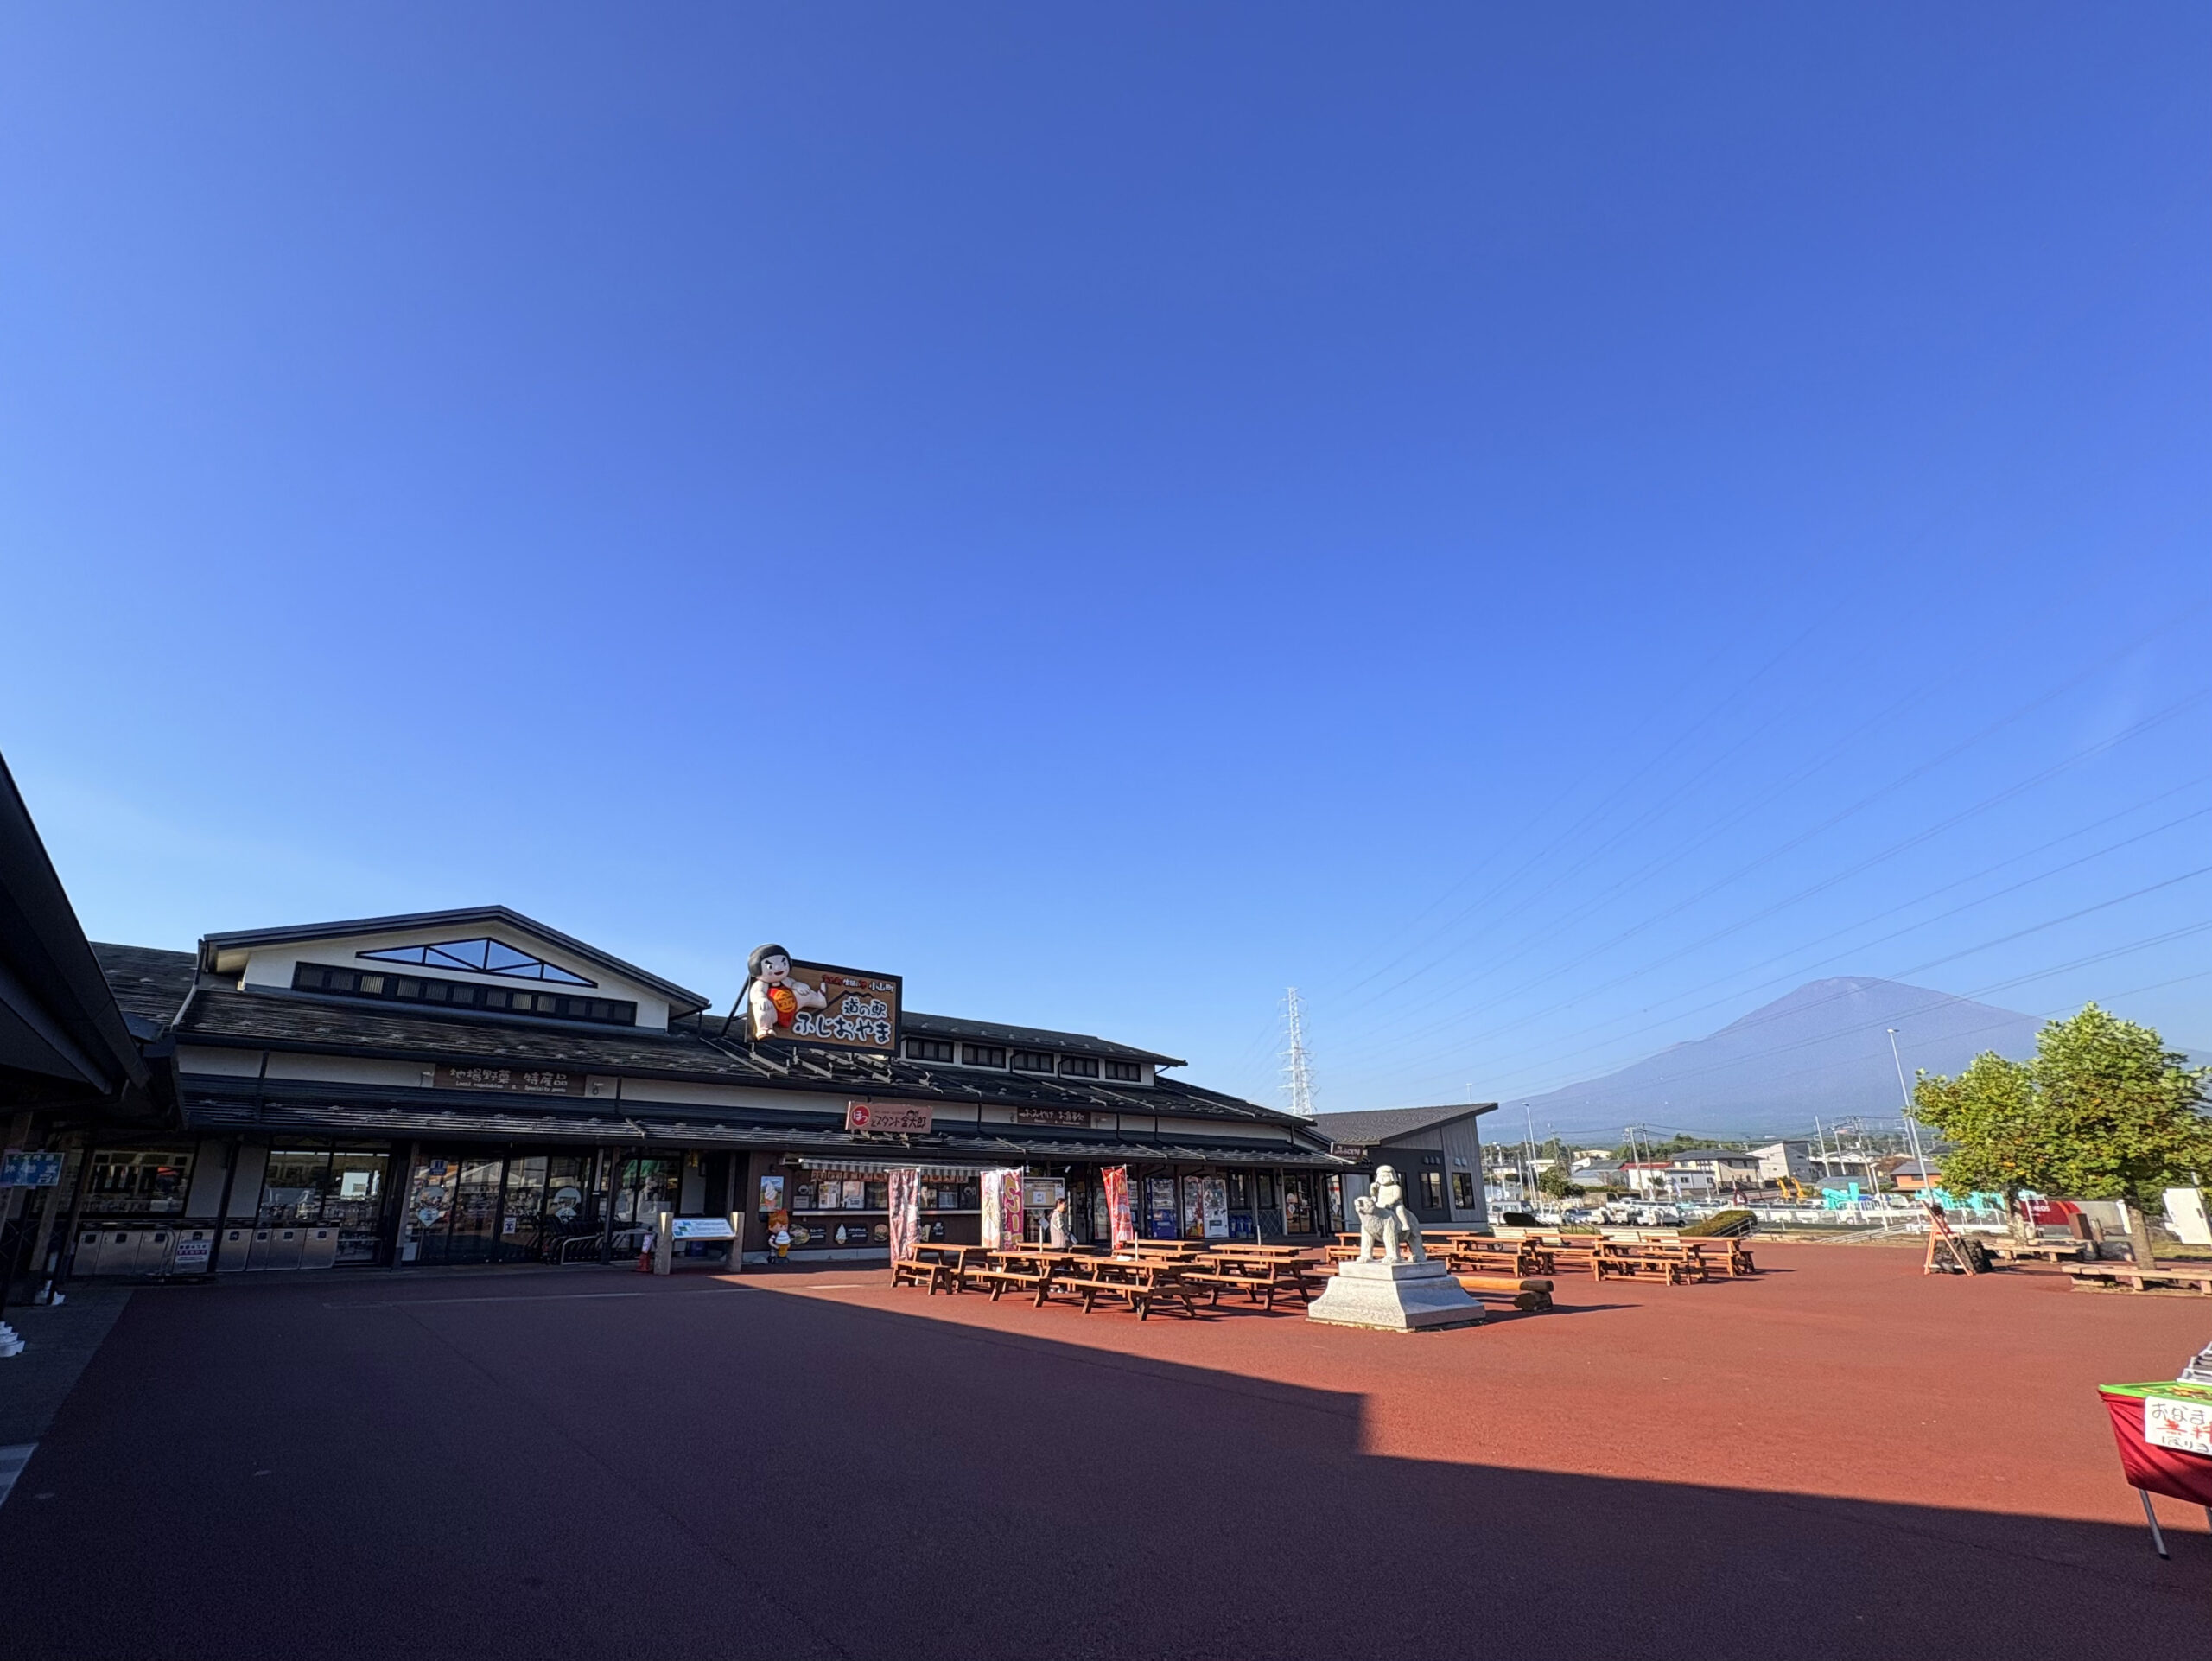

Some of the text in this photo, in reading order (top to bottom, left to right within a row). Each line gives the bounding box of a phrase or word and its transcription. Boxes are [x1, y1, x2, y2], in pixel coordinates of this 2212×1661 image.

[868, 981, 895, 994] 小山町
[842, 996, 888, 1019] 道の駅
[792, 1011, 892, 1045] ふじおやま
[450, 1068, 568, 1087] 地場野菜 特産品
[1024, 1108, 1054, 1119] おみやげ
